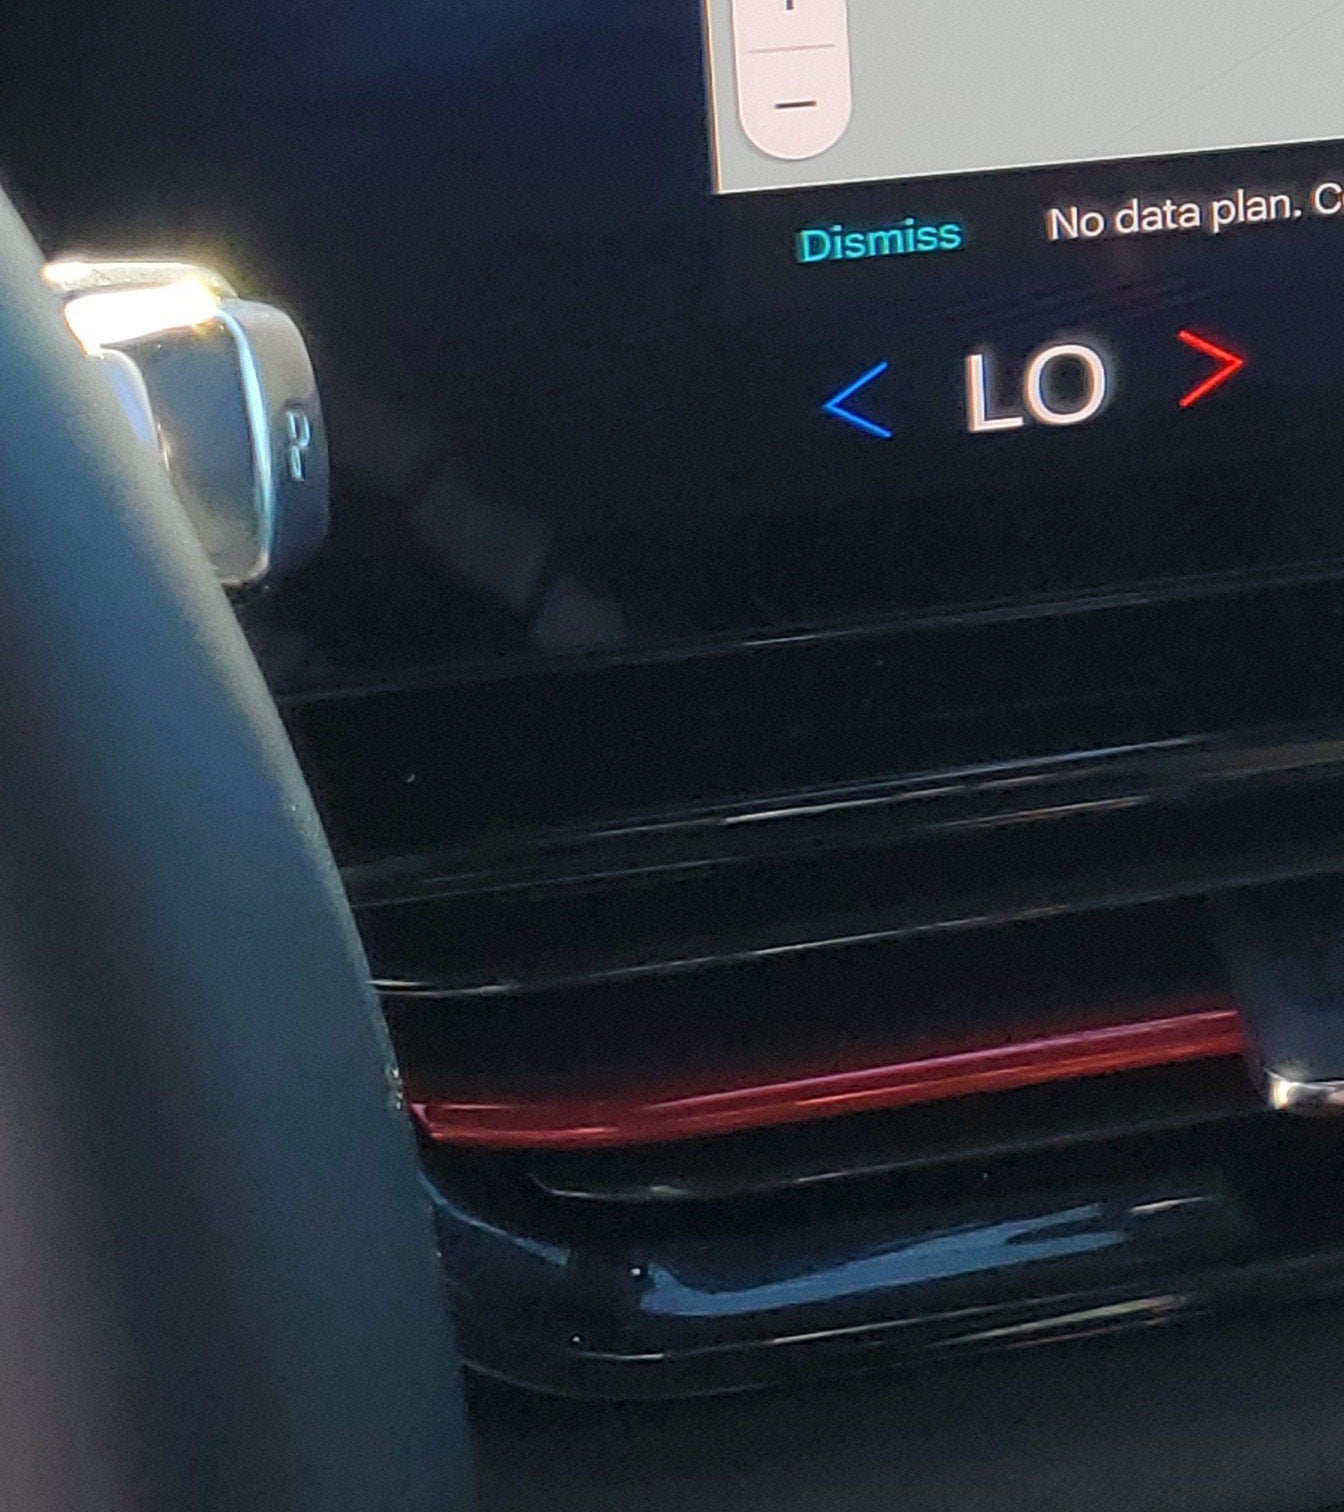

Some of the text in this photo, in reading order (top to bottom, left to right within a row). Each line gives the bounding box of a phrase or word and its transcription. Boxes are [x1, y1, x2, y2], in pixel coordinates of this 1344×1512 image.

[799, 217, 962, 262] Dismiss
[1046, 204, 1106, 241] No
[1113, 196, 1202, 234] data
[1208, 186, 1303, 236] plan.
[964, 342, 1109, 434] LO
